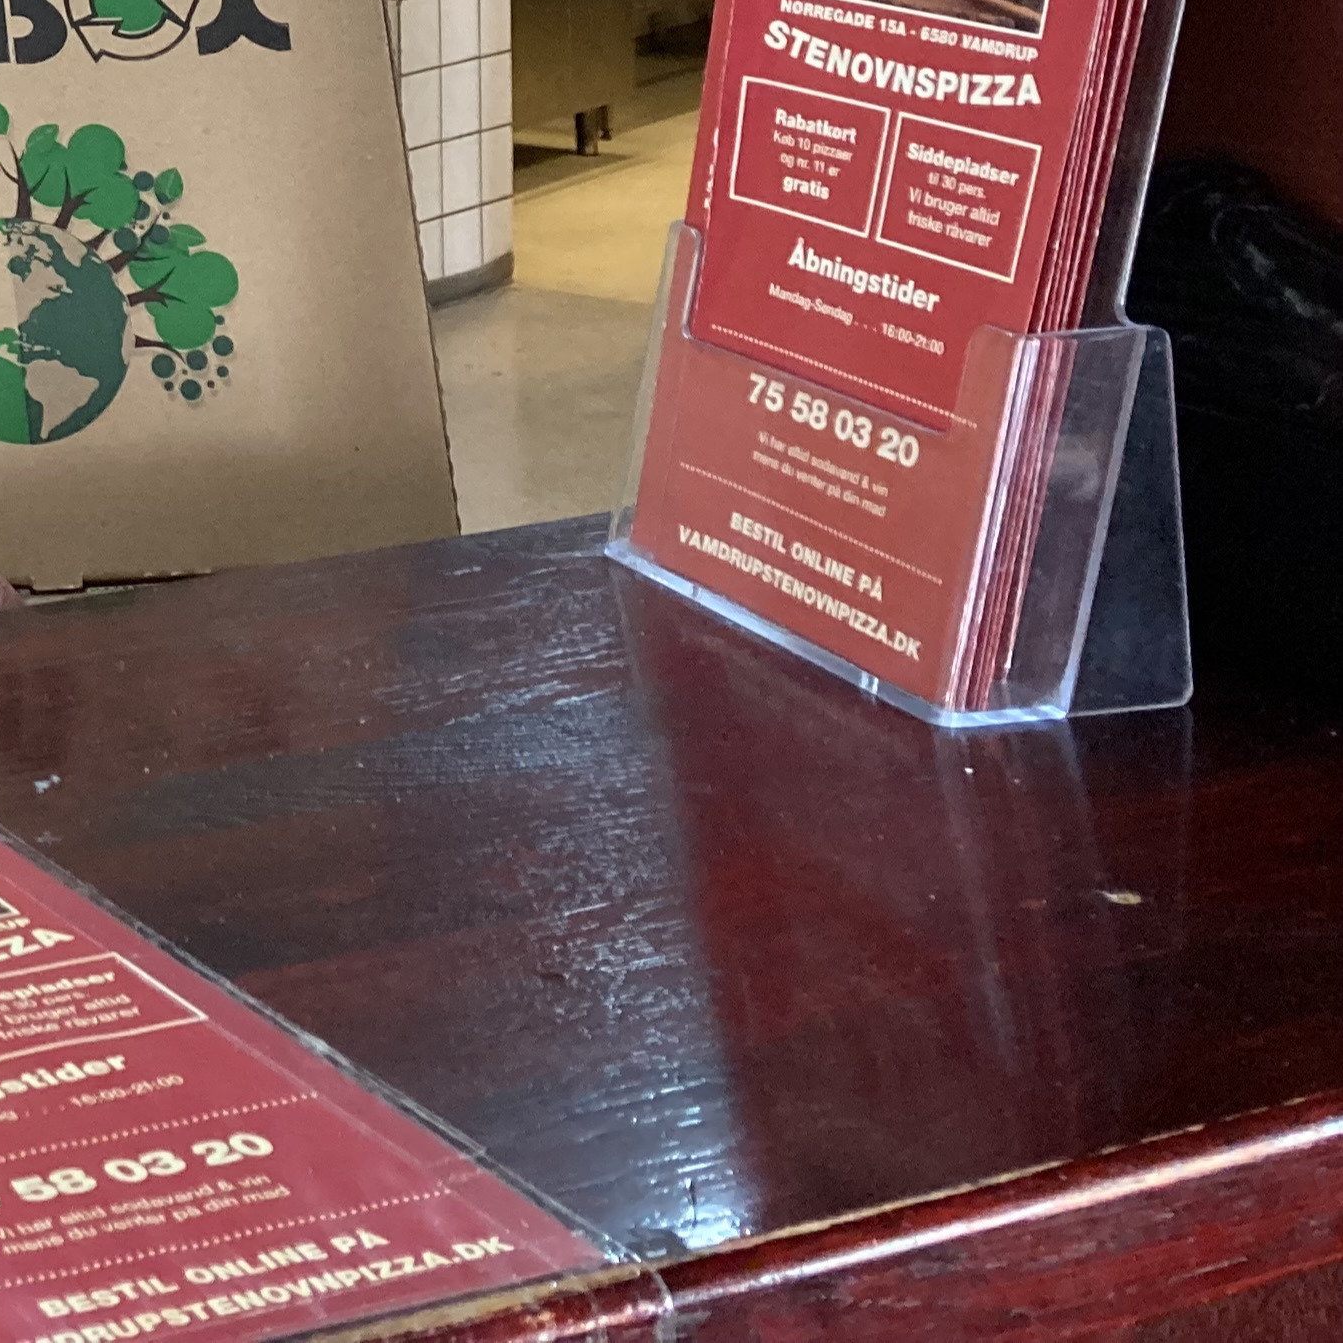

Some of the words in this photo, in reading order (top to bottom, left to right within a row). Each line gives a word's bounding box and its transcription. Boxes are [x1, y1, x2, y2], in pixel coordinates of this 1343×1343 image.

[764, 19, 1042, 107] STENOVNSPIZZA
[880, 18, 907, 36] 15A
[920, 25, 959, 47] 6580
[962, 34, 1039, 63] VAMDRUP
[774, 108, 858, 145] Rabatkort
[798, 133, 812, 151] 10
[813, 141, 854, 163] pizzaer
[780, 152, 796, 169] og
[814, 159, 826, 174] 11
[828, 166, 841, 178] er
[782, 174, 830, 201] gratis
[907, 142, 1020, 187] Siddepladser
[942, 174, 958, 191] 30
[908, 210, 944, 235] friske
[945, 221, 993, 248] råvarer
[909, 186, 922, 204] Vi
[924, 190, 970, 218] bruger
[970, 201, 1001, 227] altid
[788, 236, 941, 312] Åbningstider
[748, 371, 786, 413] 75
[790, 391, 830, 431] 58
[834, 408, 873, 449] 03
[876, 426, 920, 468] 20
[752, 450, 780, 471] mens
[781, 461, 795, 478] du
[796, 468, 828, 491] venter
[827, 480, 842, 500] på
[842, 489, 861, 507] din
[770, 433, 786, 454] har
[810, 454, 863, 487] sodavand
[730, 511, 788, 555] BESTIL
[790, 541, 856, 588] ONLINE
[857, 573, 884, 603] PÅ
[678, 523, 922, 662] VAMDRUPSTENOVNPIZZA.DK
[10, 1166, 98, 1205] 58
[103, 1149, 187, 1183] 03
[190, 1131, 274, 1166] 20
[3, 1234, 65, 1255] mens
[66, 1225, 98, 1242] du
[100, 1213, 167, 1233] venter
[171, 1205, 203, 1223] på
[203, 1196, 240, 1213] din
[241, 1183, 292, 1203] mad
[16, 1218, 54, 1235] har
[110, 1183, 215, 1215] sodavand
[36, 1275, 182, 1319] BESTIL
[183, 1241, 329, 1286] ONLINE
[329, 1227, 391, 1256] PÅ
